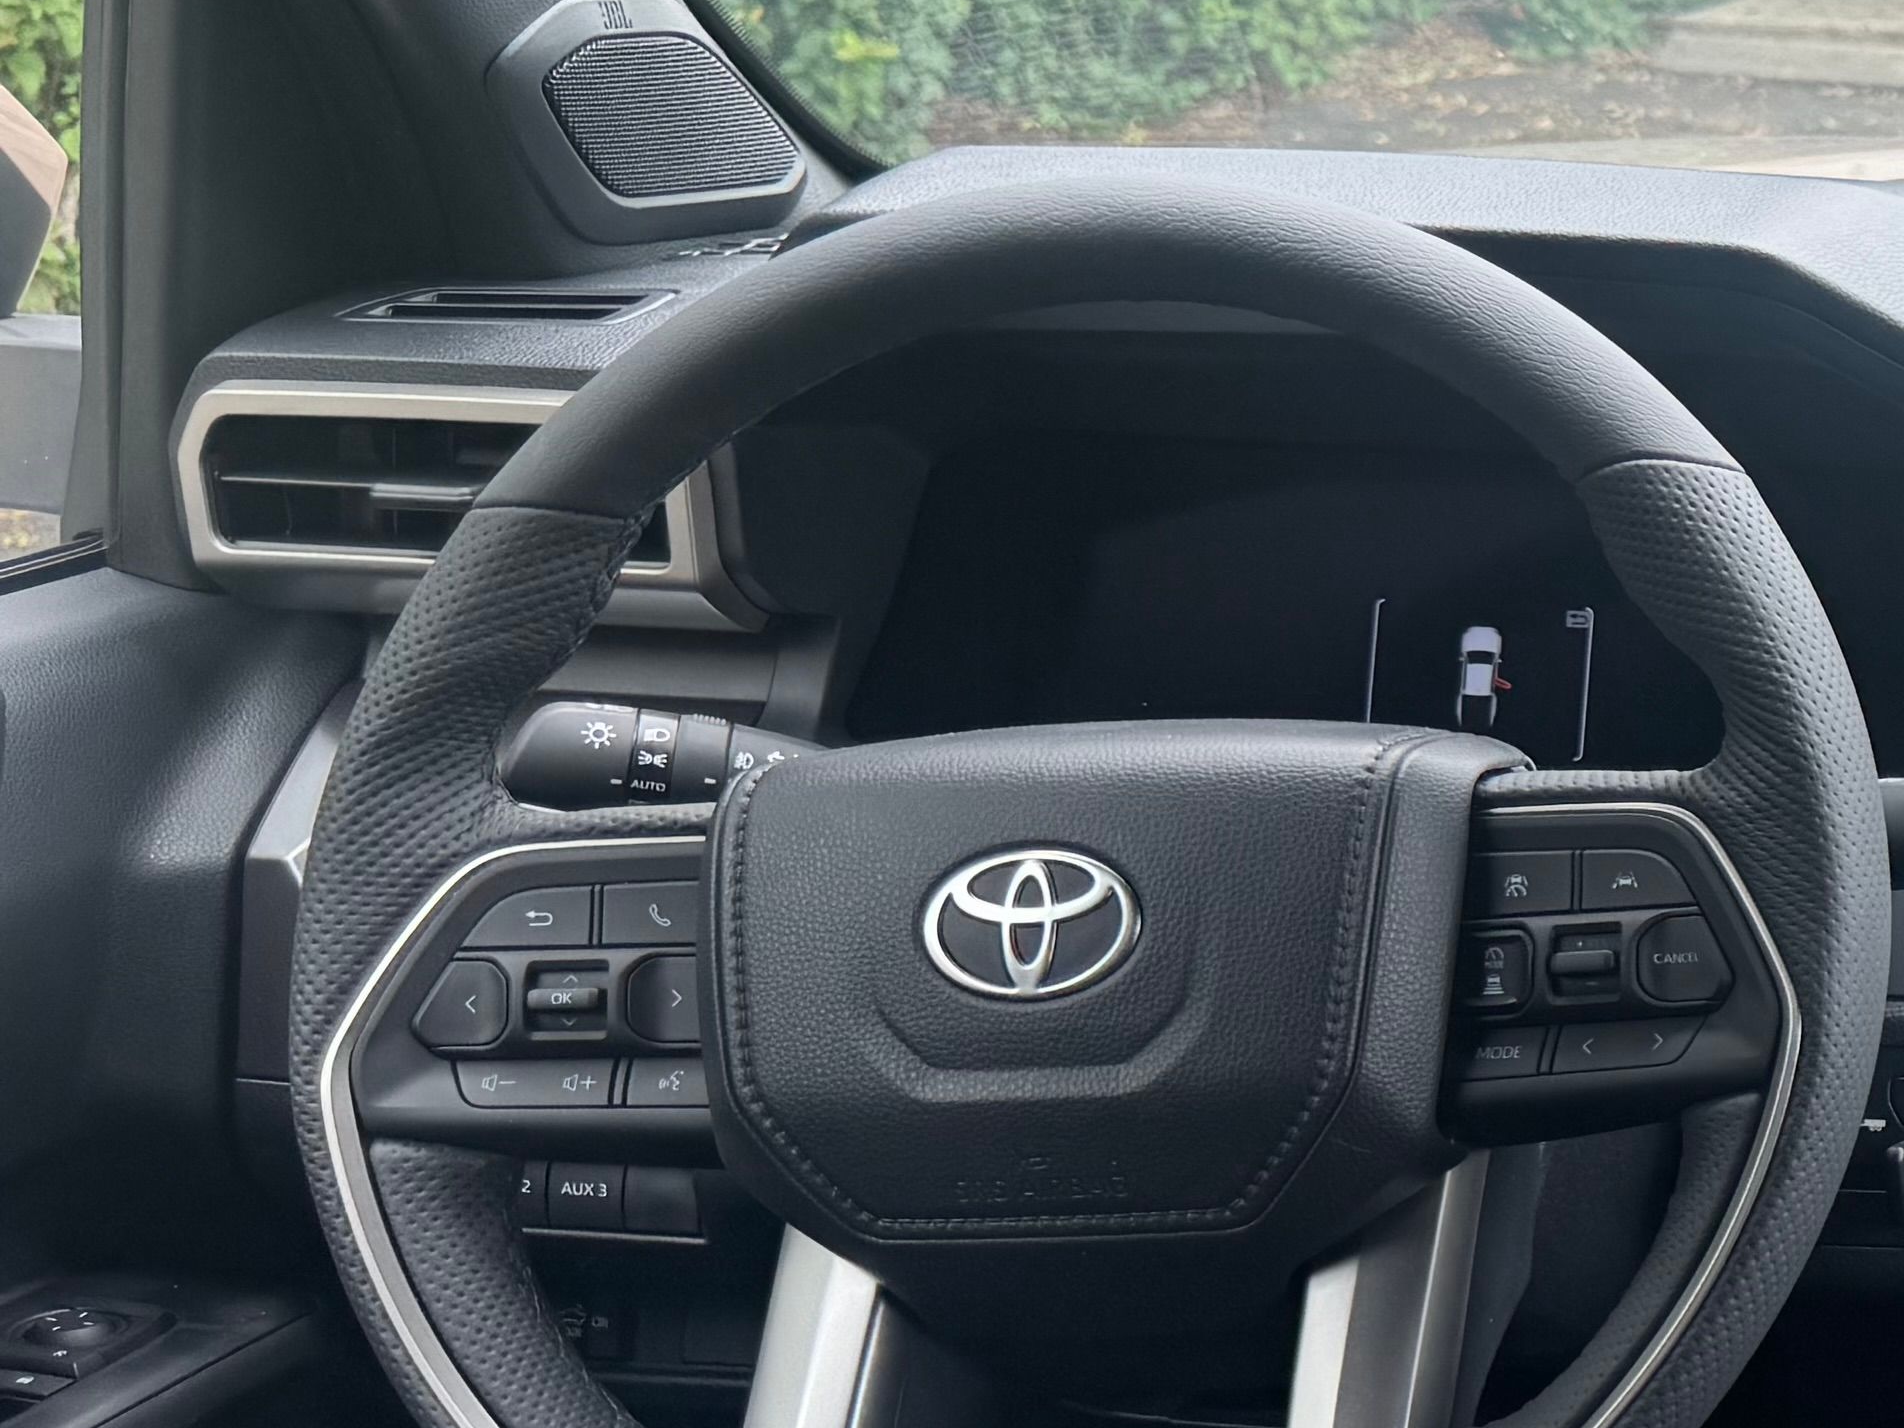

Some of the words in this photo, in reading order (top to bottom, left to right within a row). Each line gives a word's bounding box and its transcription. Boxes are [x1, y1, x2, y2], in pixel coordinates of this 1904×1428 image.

[598, 0, 633, 30] JBL
[630, 779, 666, 792] AUTO
[1653, 951, 1699, 964] CANCEL
[551, 991, 573, 1005] OK
[1476, 1045, 1522, 1059] MODE
[521, 1179, 531, 1193] 2
[560, 1181, 594, 1196] AUX
[598, 1183, 607, 1197] 3
